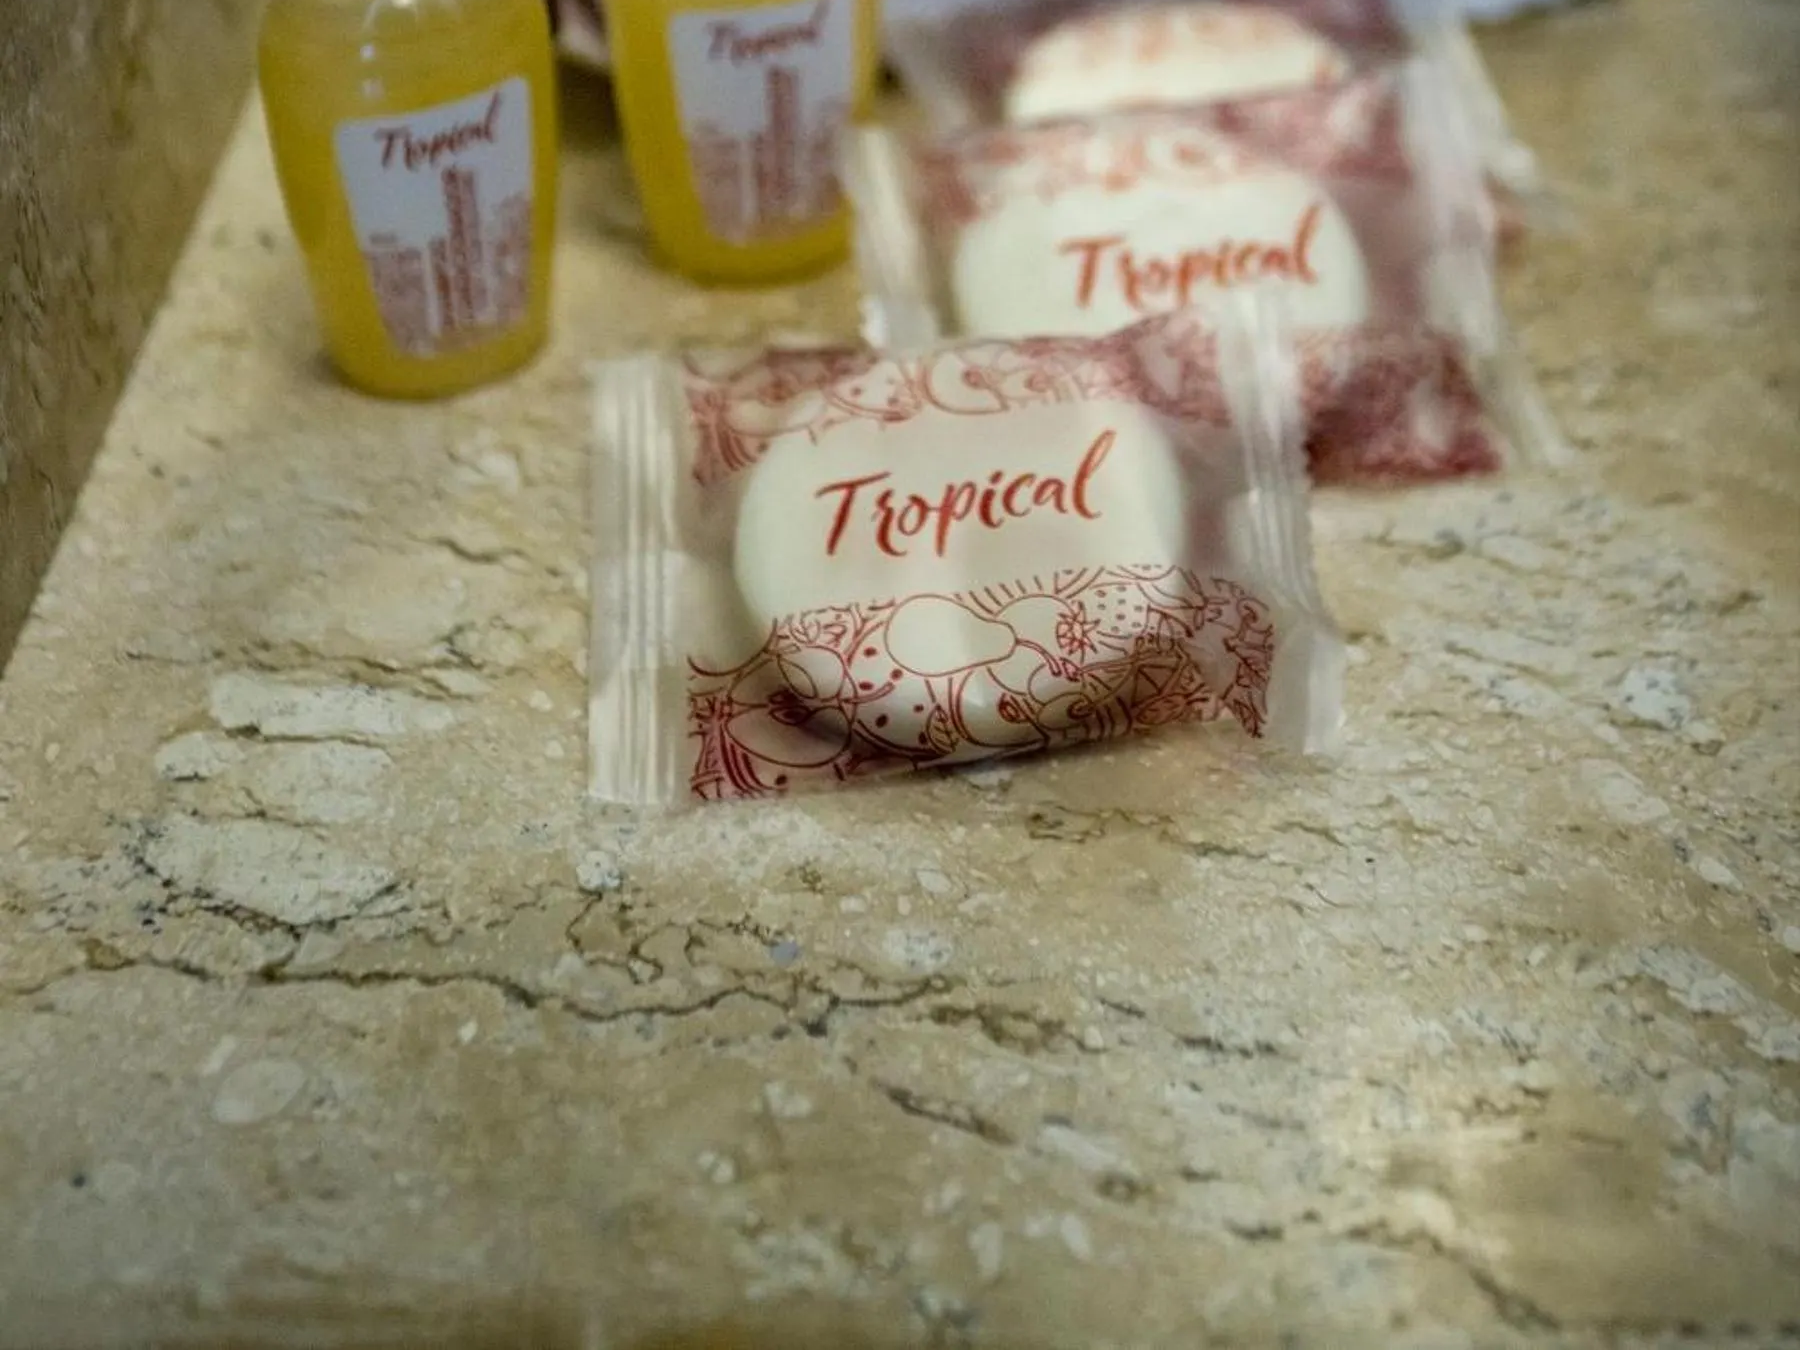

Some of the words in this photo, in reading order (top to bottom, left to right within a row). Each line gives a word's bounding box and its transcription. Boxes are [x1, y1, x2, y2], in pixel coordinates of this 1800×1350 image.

[374, 91, 500, 171] Tropical
[1058, 203, 1321, 310] Tropical
[813, 429, 1117, 557] Tropical
